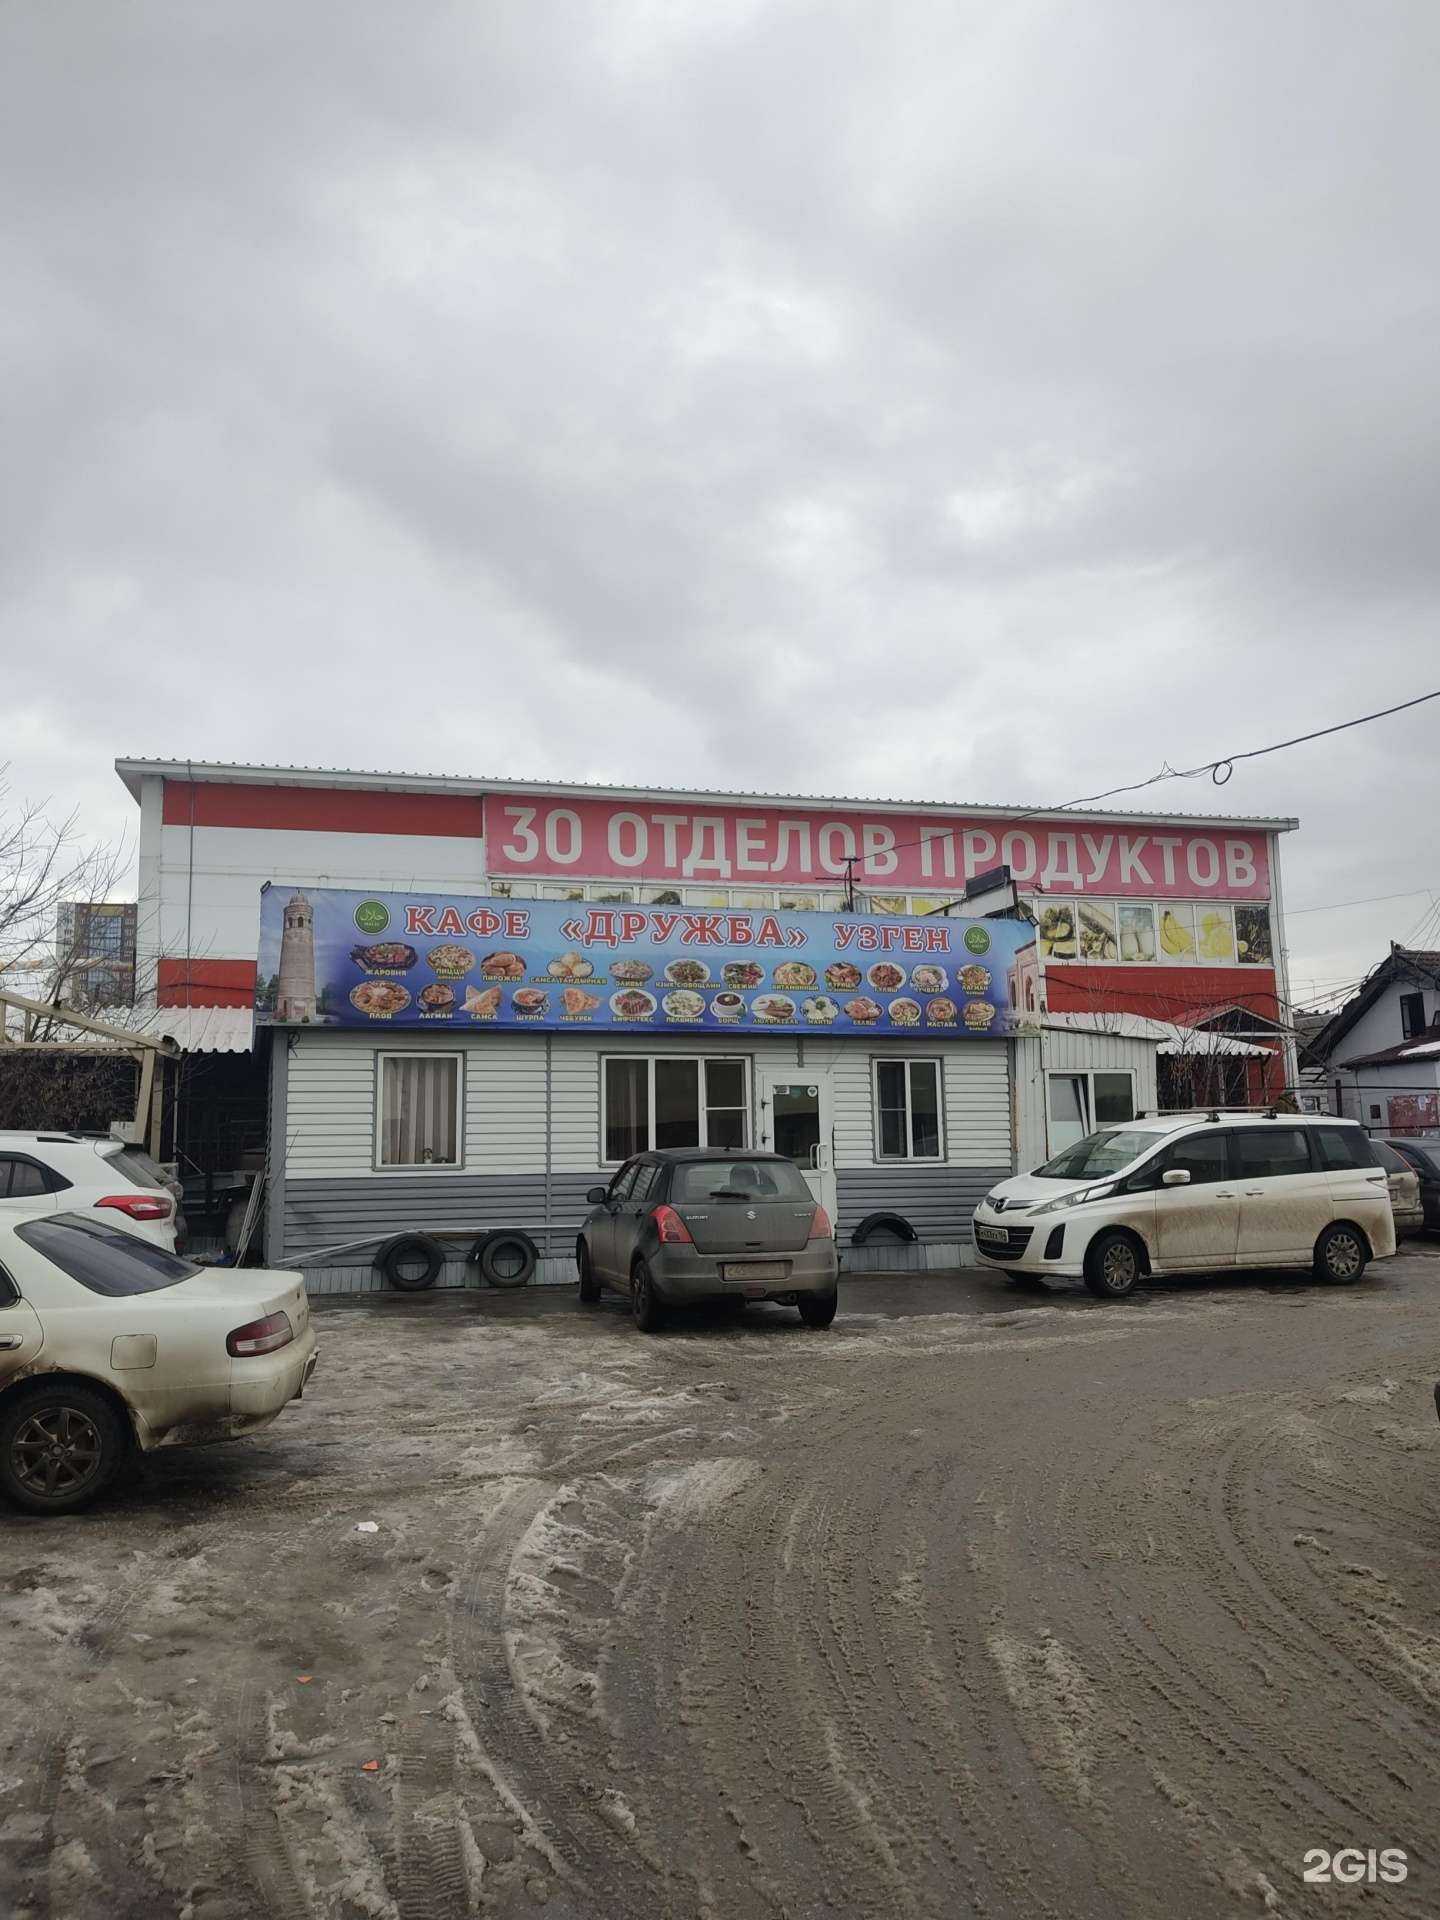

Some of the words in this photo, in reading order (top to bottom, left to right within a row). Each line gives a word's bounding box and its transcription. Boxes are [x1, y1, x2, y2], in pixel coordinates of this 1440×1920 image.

[502, 806, 583, 865] 30
[607, 812, 899, 879] ОТДЕЛОВ
[919, 827, 1257, 890] ПРОДУКТОВ
[405, 906, 530, 939] КАФЕ
[560, 909, 807, 948] «ДРУЖБА»
[834, 924, 951, 952] УЗГЕН
[364, 969, 407, 977] ЖАРОВНЯ
[435, 968, 465, 976] ПИЦЦА
